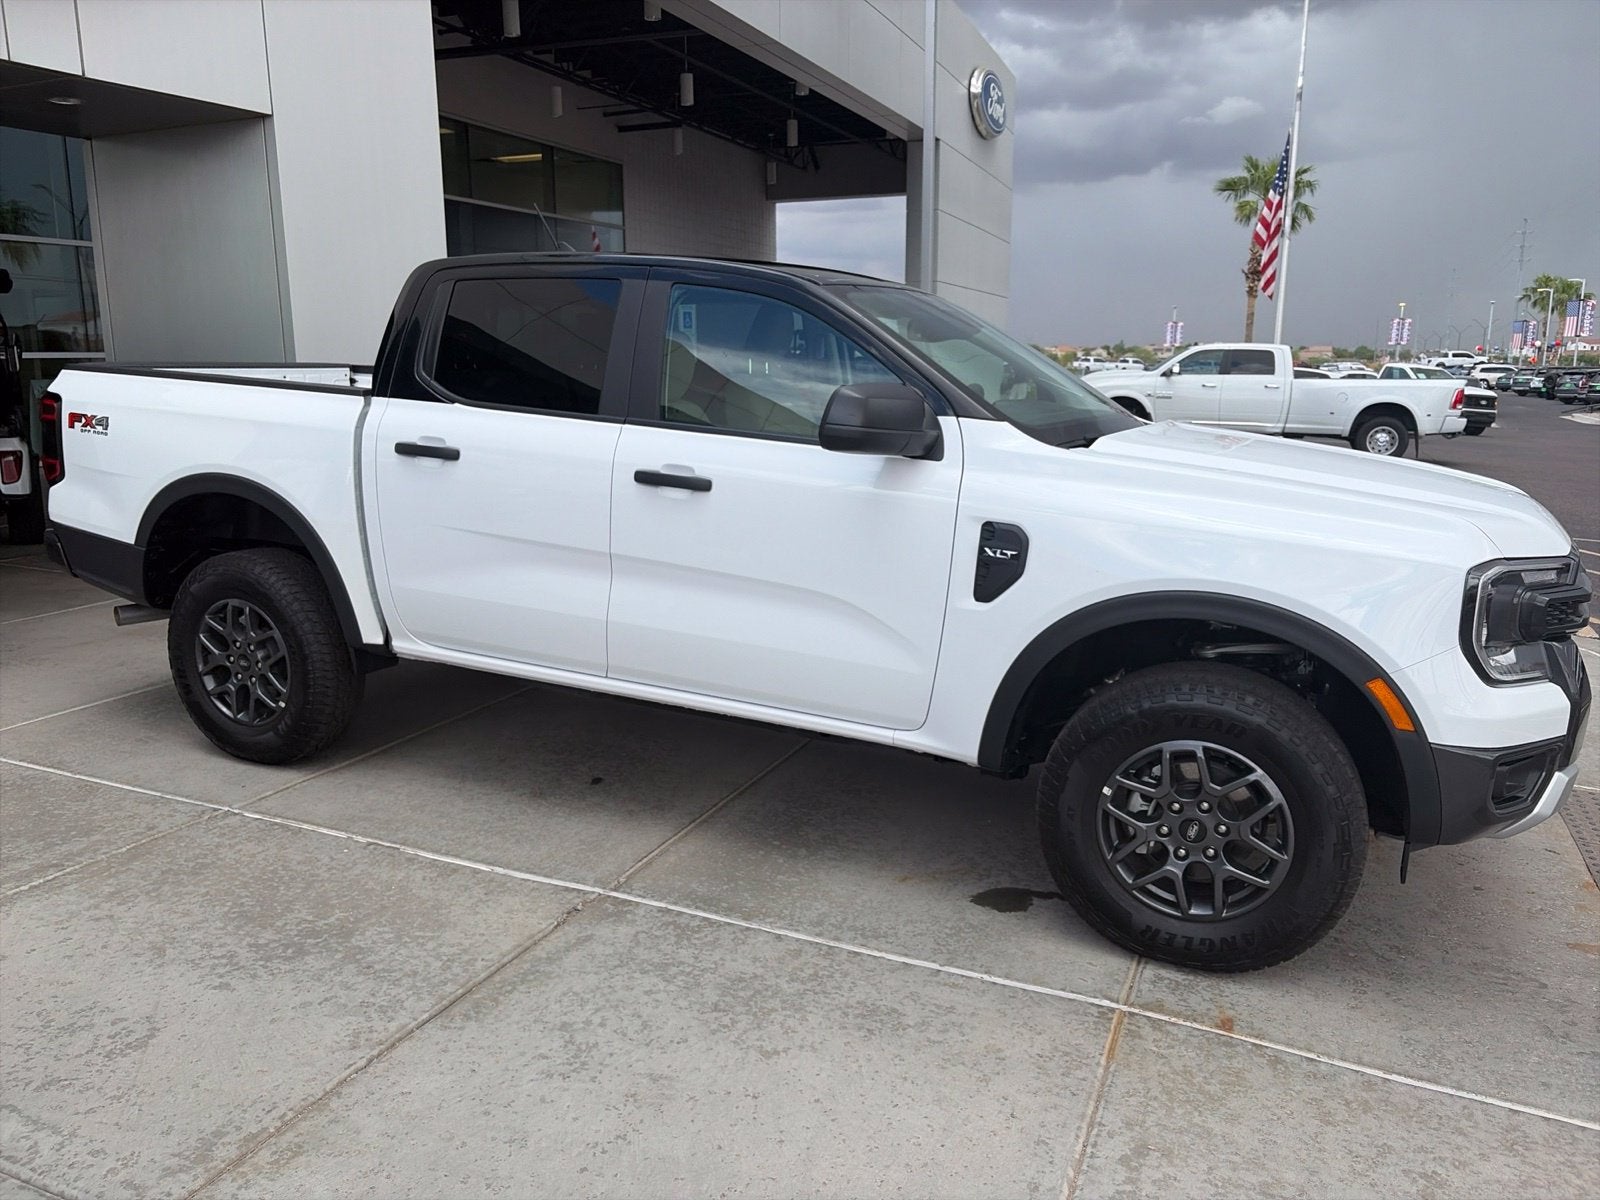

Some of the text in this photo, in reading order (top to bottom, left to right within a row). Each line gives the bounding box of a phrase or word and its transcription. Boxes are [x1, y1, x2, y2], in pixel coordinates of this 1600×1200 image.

[988, 82, 1005, 124] Ford
[68, 412, 110, 431] FX4
[983, 547, 1019, 559] XLT
